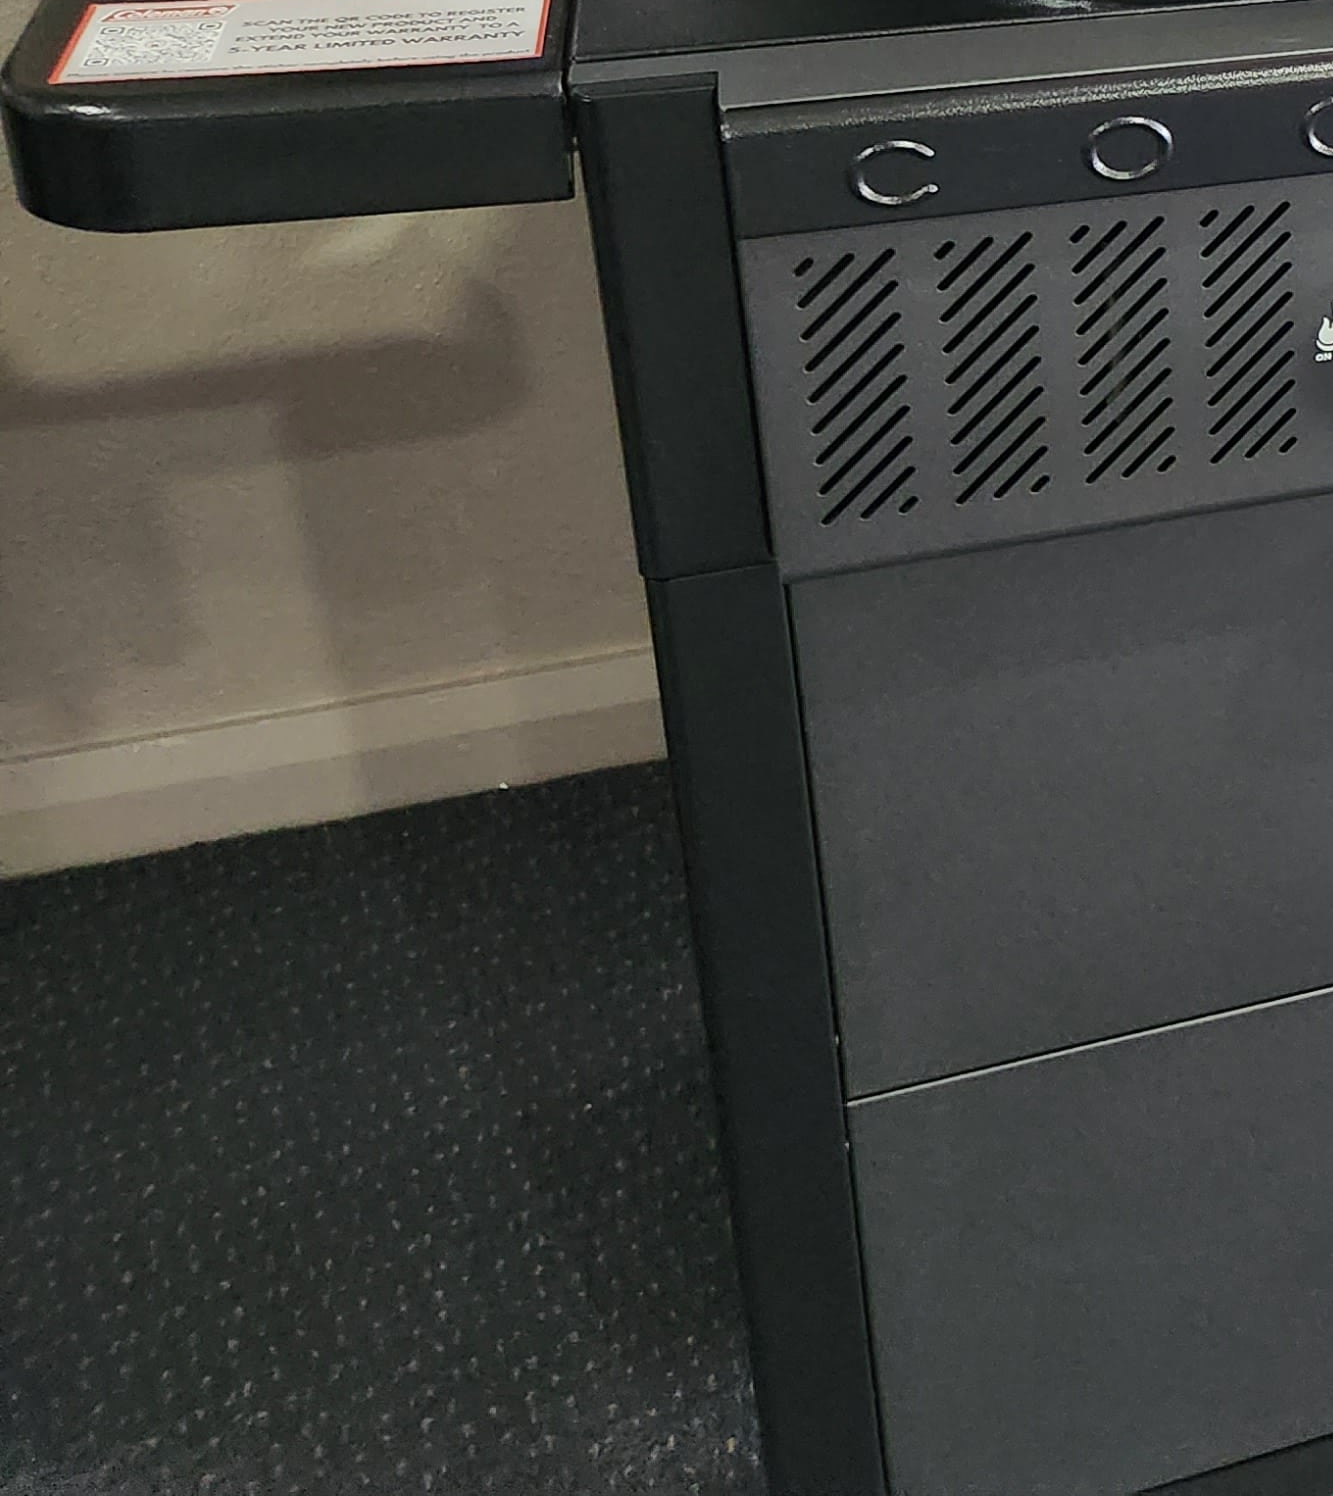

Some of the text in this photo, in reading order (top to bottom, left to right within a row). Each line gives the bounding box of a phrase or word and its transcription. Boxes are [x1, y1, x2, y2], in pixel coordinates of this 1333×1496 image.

[365, 13, 410, 21] CODE
[447, 7, 525, 16] REGISTER
[371, 18, 453, 27] PRODUCT
[235, 33, 305, 42] EXTEND
[312, 30, 360, 38] YOUR
[366, 24, 469, 35] WARRANTY
[228, 30, 526, 54] 5-YEAR LIMITED WARRANTY
[1315, 352, 1333, 362] ON
